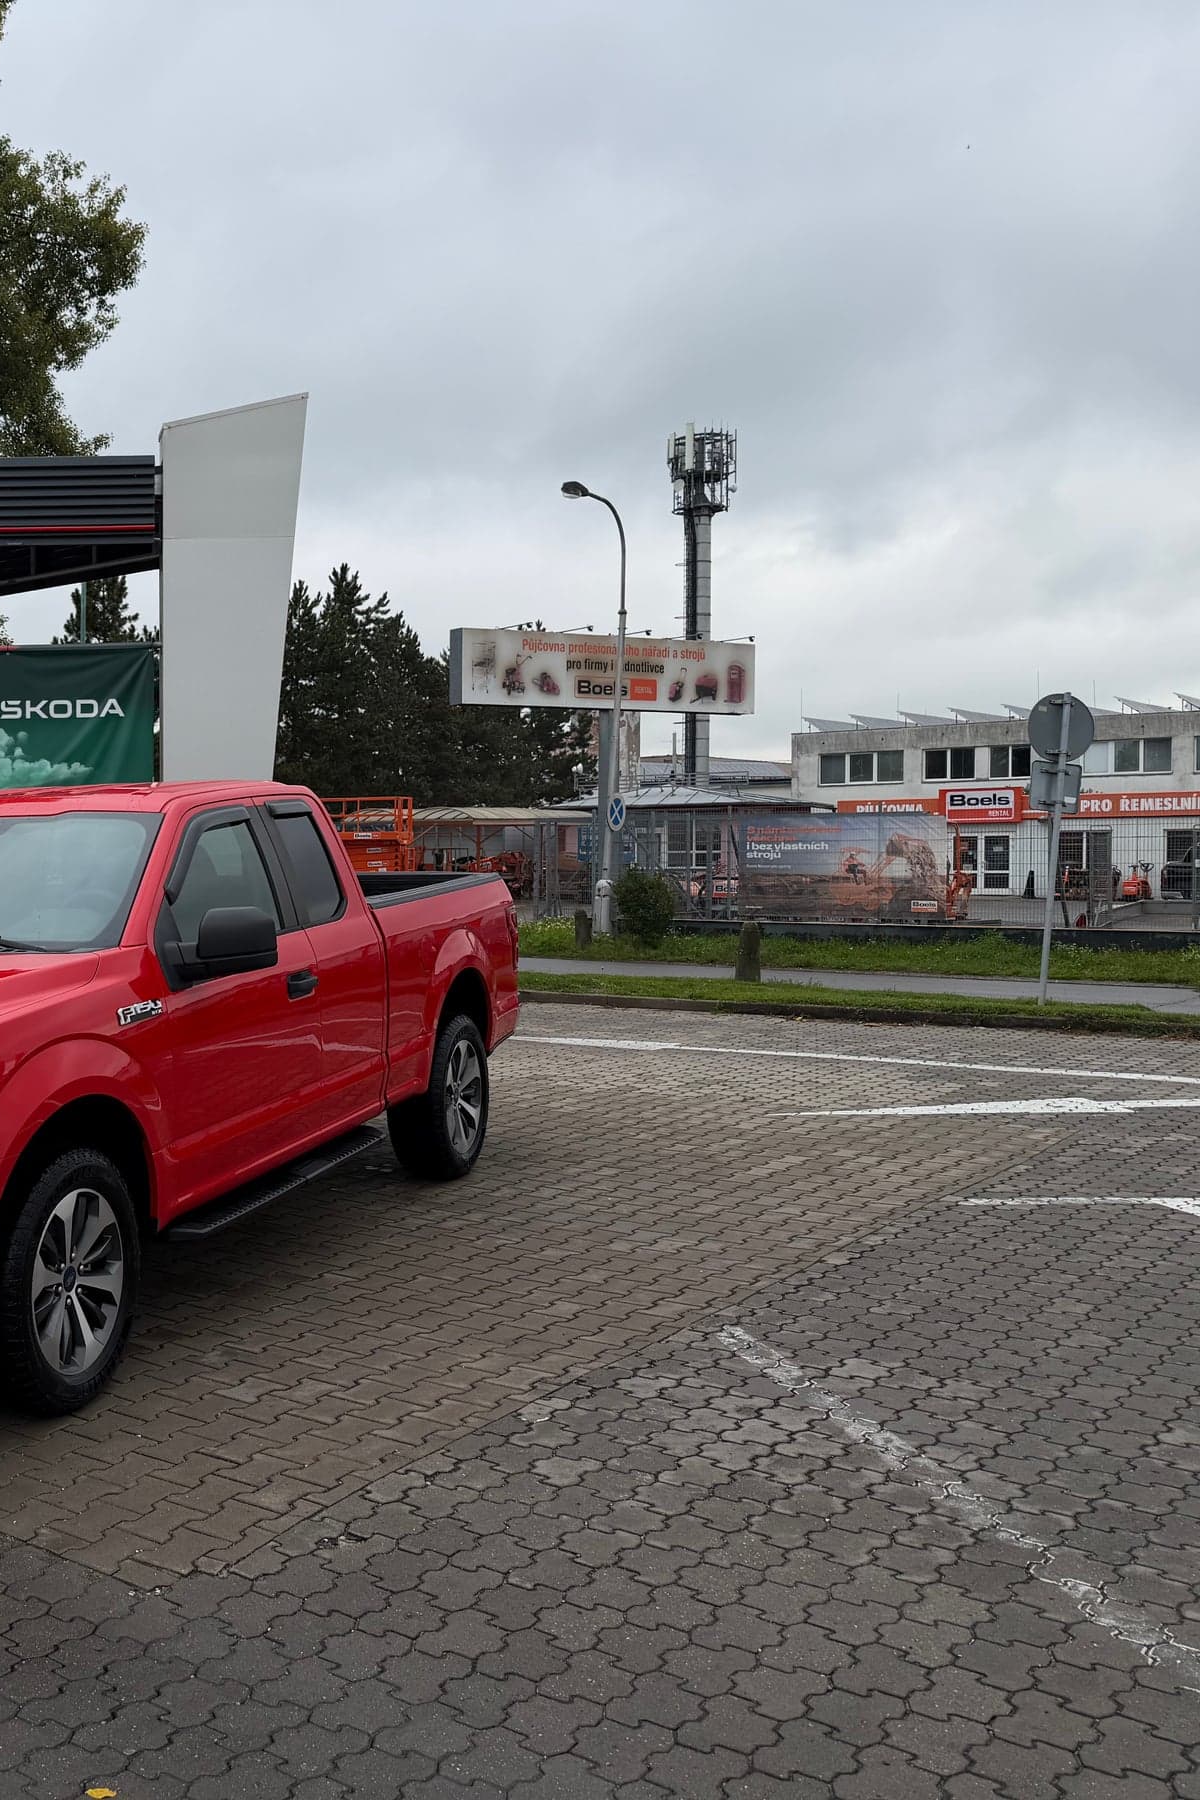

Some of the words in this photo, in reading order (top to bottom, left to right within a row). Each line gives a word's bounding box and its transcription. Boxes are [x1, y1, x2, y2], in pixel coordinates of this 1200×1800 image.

[522, 638, 565, 653] Půjčovna
[672, 649, 678, 657] a
[680, 647, 706, 663] strojů
[566, 660, 582, 672] pro
[584, 658, 608, 673] firmy
[610, 659, 614, 671] i
[617, 660, 665, 674] dnotlivce
[949, 793, 1010, 807] Boels
[1080, 799, 1113, 813] PRO
[746, 842, 750, 850] i
[751, 842, 773, 850] bez
[774, 842, 829, 850] vlastních
[746, 850, 781, 860] strojů
